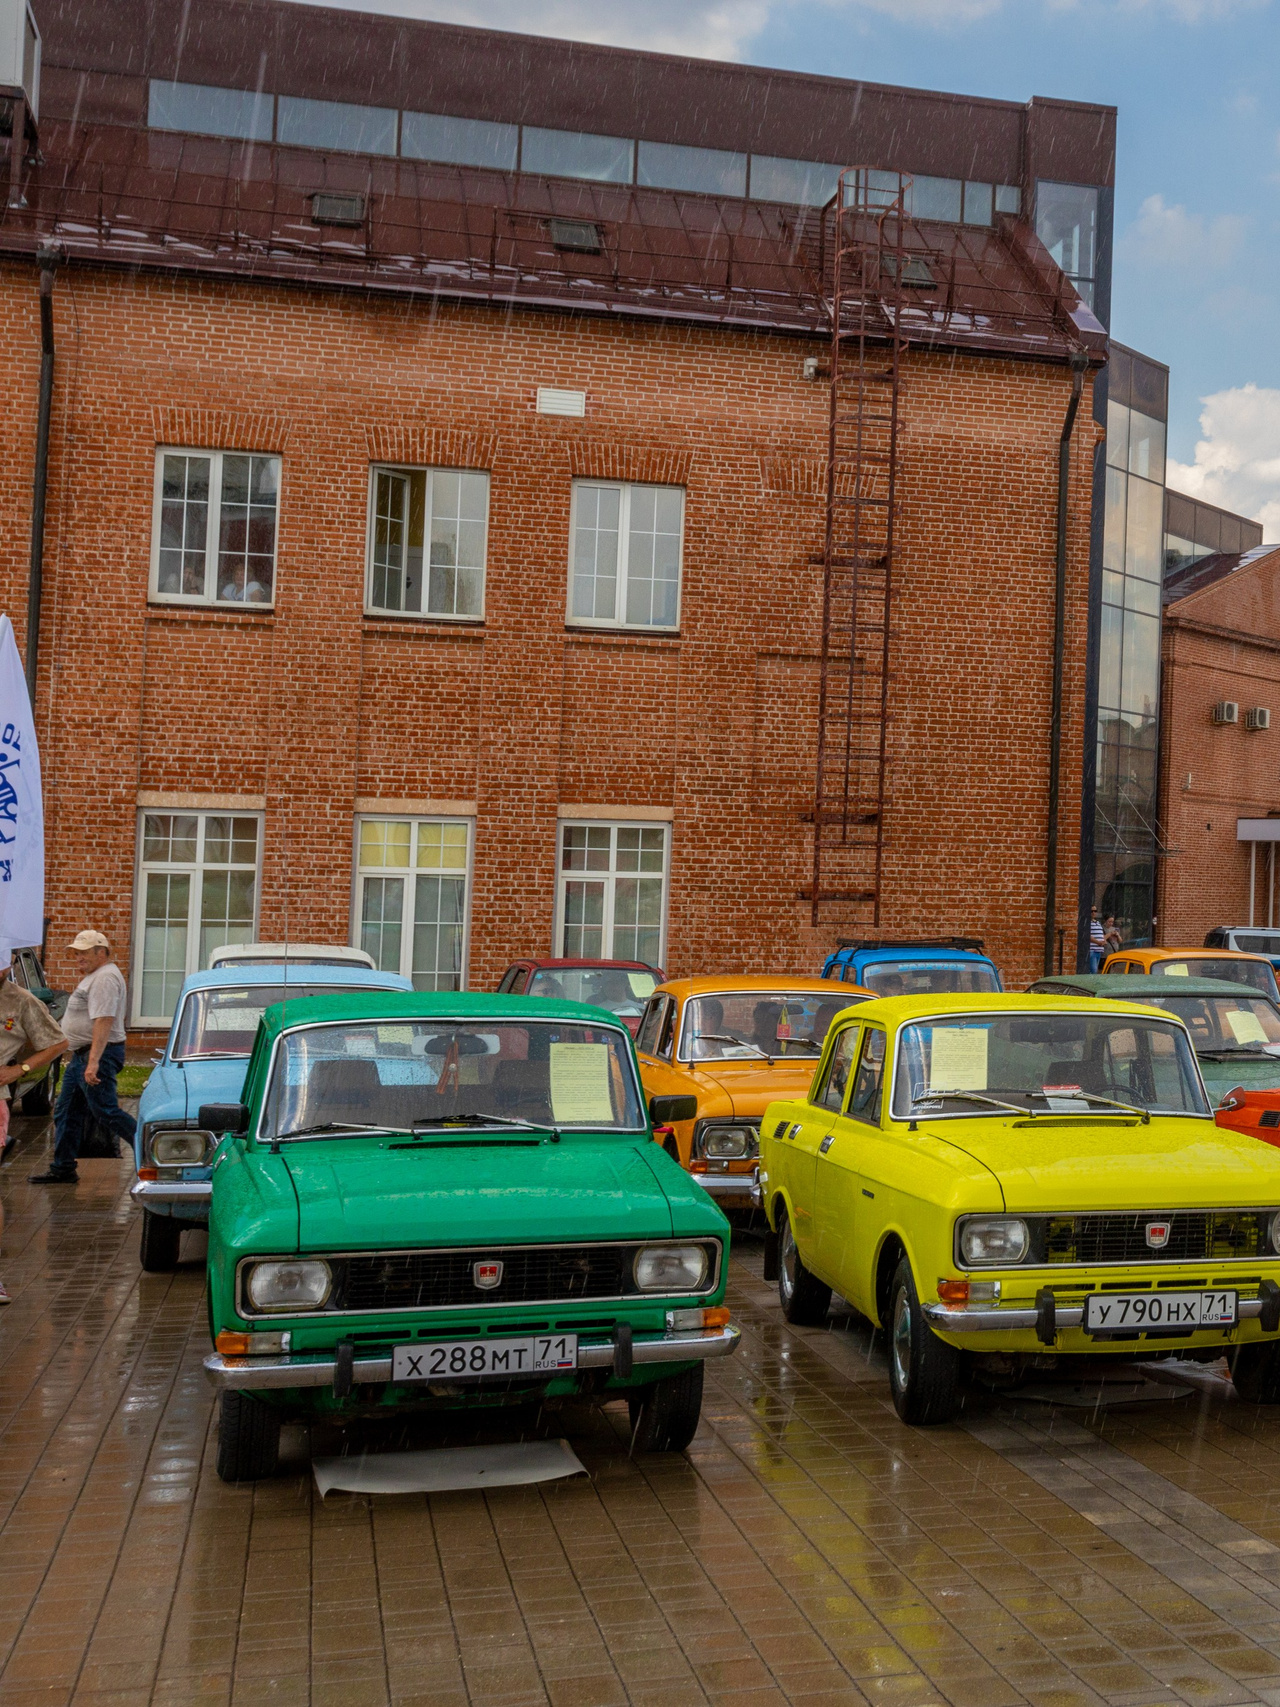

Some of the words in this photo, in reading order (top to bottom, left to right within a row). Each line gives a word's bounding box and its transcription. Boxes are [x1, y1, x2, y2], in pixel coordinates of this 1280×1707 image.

[1204, 1294, 1228, 1313] 71
[1202, 1313, 1219, 1321] RUS
[538, 1338, 567, 1359] 71
[535, 1359, 557, 1369] RUS
